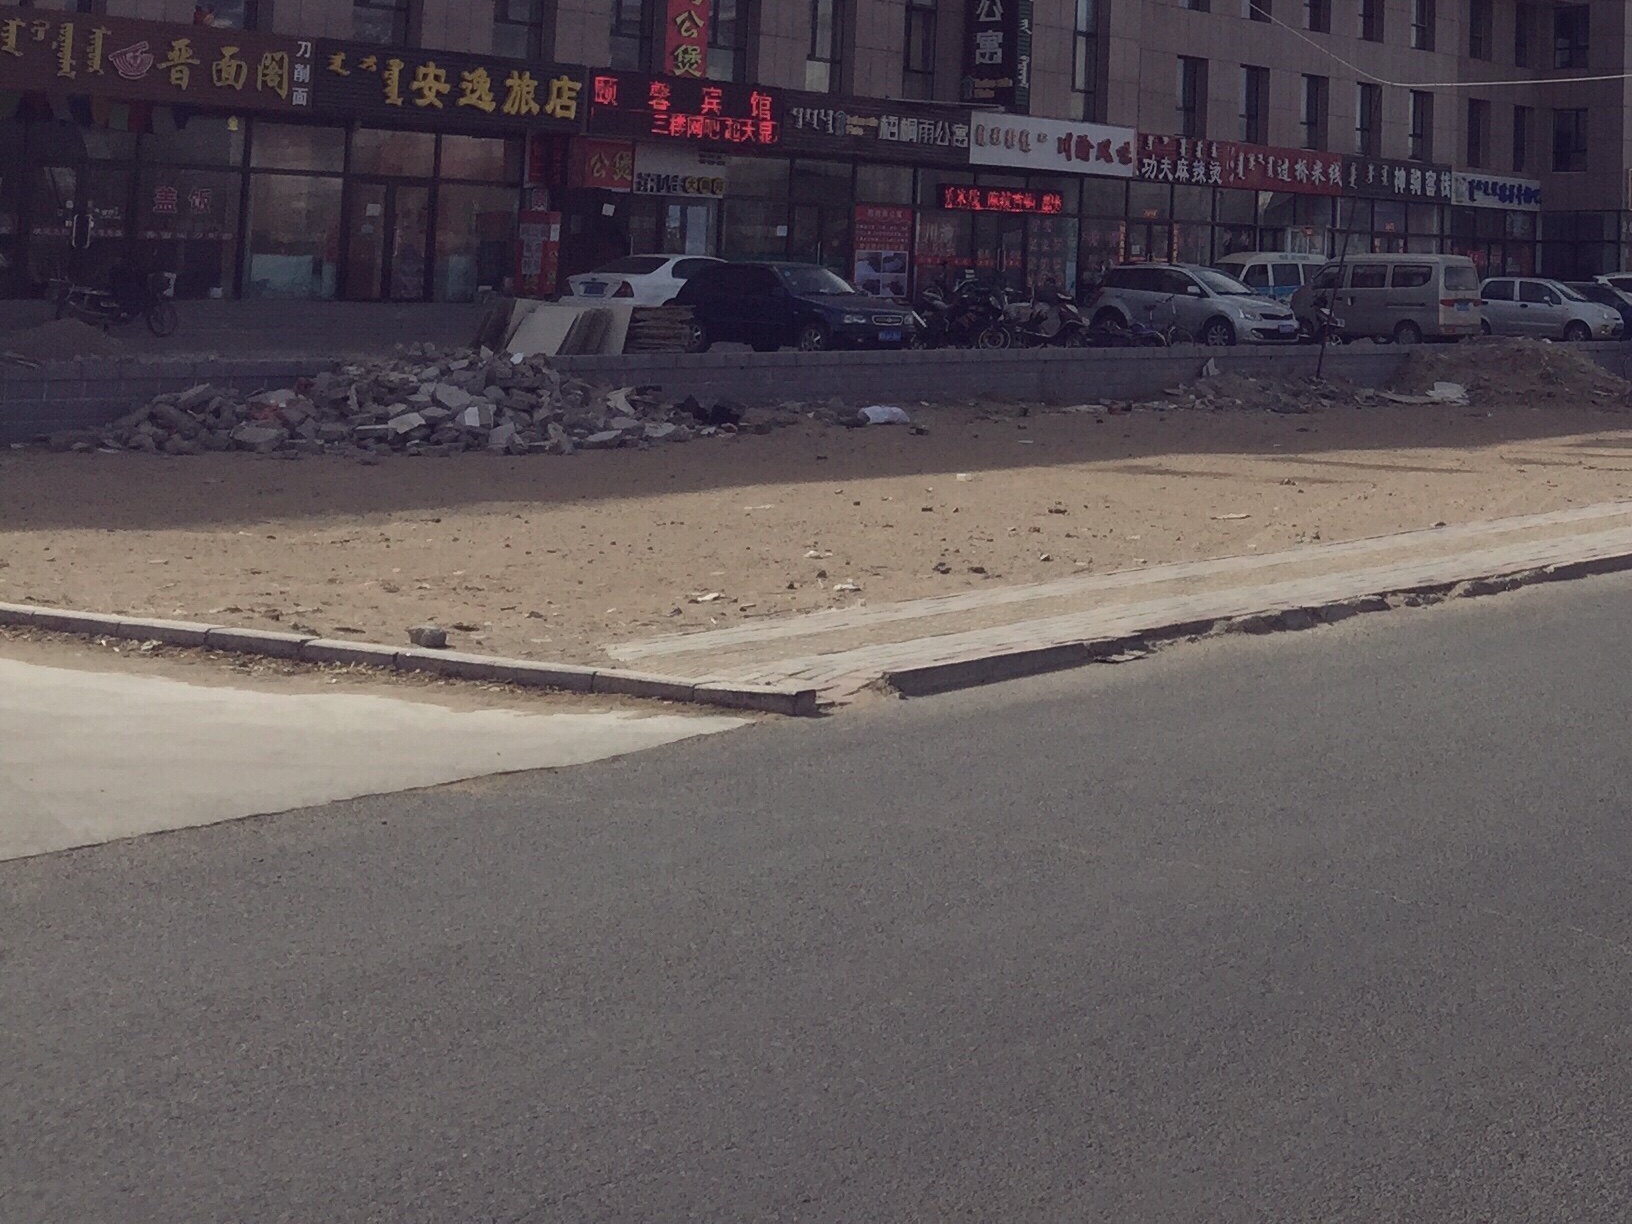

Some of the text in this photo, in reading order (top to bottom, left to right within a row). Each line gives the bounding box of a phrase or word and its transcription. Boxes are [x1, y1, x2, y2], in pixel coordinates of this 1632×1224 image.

[292, 40, 312, 107] 刀削面
[409, 60, 583, 121] 安逸旅店
[593, 75, 774, 121] 颐馨宾馆
[878, 114, 969, 149] 梧桐雨公寓
[1141, 154, 1223, 185] 功夫麻辣烫
[1277, 158, 1343, 188] 过桥米线
